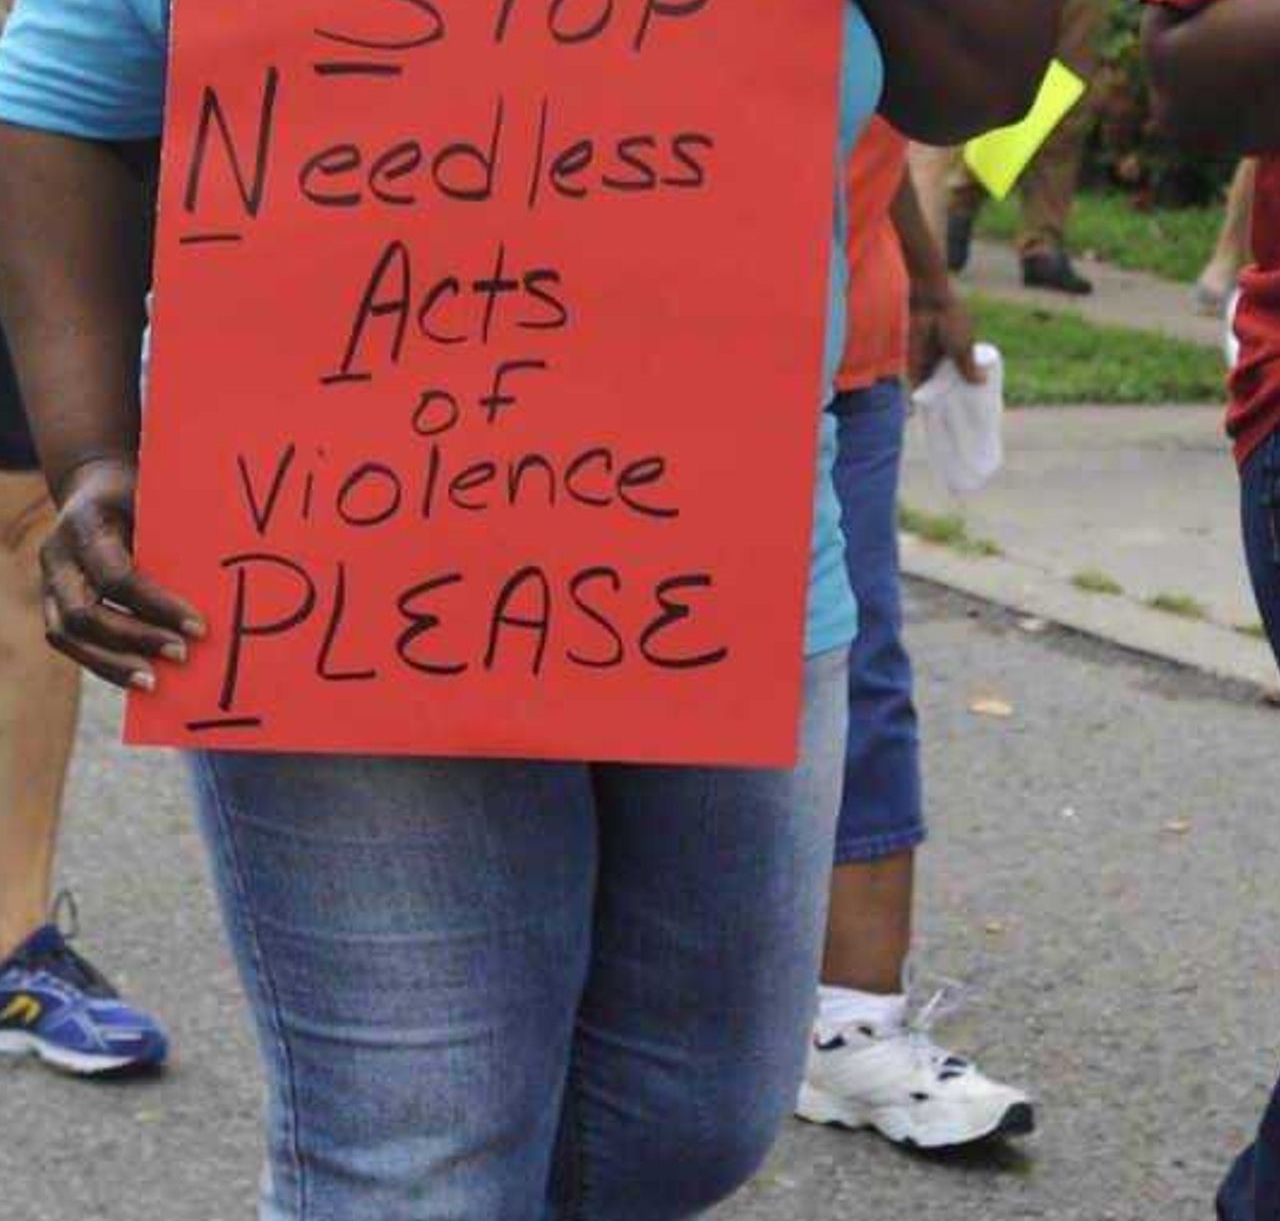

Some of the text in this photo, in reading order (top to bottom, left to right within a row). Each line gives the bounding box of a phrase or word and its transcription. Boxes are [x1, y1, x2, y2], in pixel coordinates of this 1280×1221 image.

[182, 66, 714, 220] Needless
[323, 240, 568, 382] Acts
[238, 443, 680, 534] Violence
[216, 553, 728, 714] PLEASE
